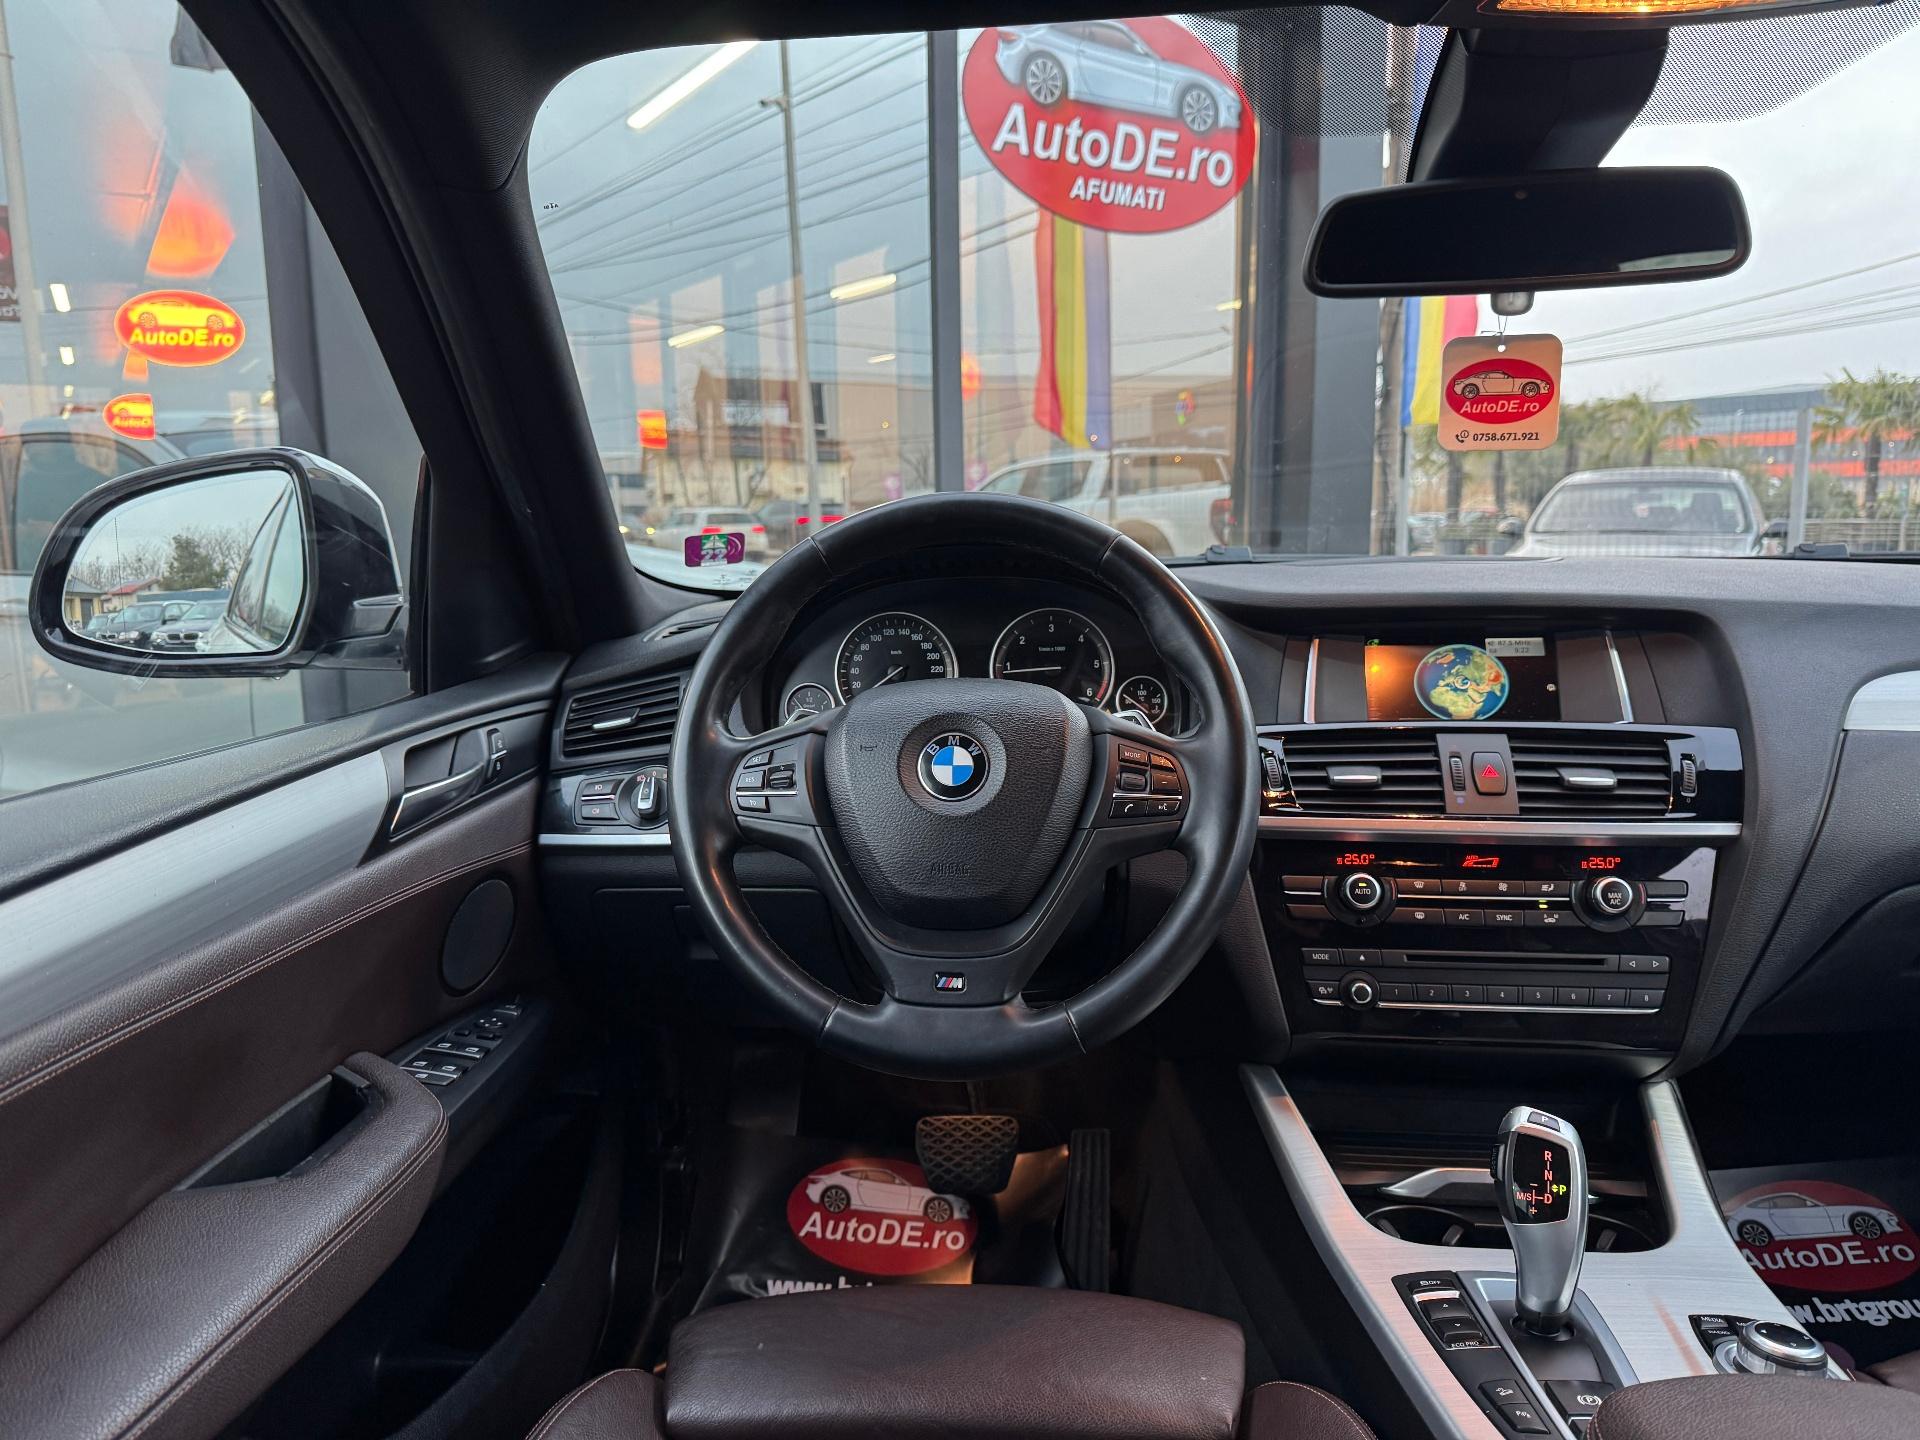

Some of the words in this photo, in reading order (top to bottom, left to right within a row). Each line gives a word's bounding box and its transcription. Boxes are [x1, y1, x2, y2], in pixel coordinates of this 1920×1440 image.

[991, 103, 1235, 188] AutoDE.ro
[1070, 176, 1165, 211] AFUMATI
[129, 328, 236, 347] AutoDE.ro
[1460, 400, 1540, 414] AutoDE.ro
[1472, 432, 1540, 441] 0758.671.921
[883, 628, 895, 636] 120
[898, 628, 910, 636] 140
[1048, 624, 1055, 632] 3
[870, 634, 882, 642] 100
[911, 633, 923, 641] 160
[1019, 636, 1026, 645] 2
[1078, 634, 1084, 643] 4
[860, 643, 870, 651] 80
[920, 642, 933, 650] 180
[853, 654, 863, 662] 60
[926, 652, 940, 660] 200
[1005, 661, 1011, 671] 1
[1093, 660, 1100, 668] 5
[850, 667, 860, 675] 40
[930, 665, 944, 673] 220
[852, 681, 861, 689] 20
[1086, 688, 1093, 697] 6
[927, 735, 982, 757] BMW
[1458, 913, 1470, 921] A/C
[1394, 988, 1399, 996] 1
[1544, 1150, 1553, 1161] R
[1544, 1170, 1553, 1181] N
[1559, 1184, 1567, 1196] P
[1516, 1191, 1532, 1200] M/S
[1544, 1193, 1553, 1205] D
[798, 1211, 966, 1250] AutoDE.ro
[1742, 1240, 1916, 1270] AutoDE.ro
